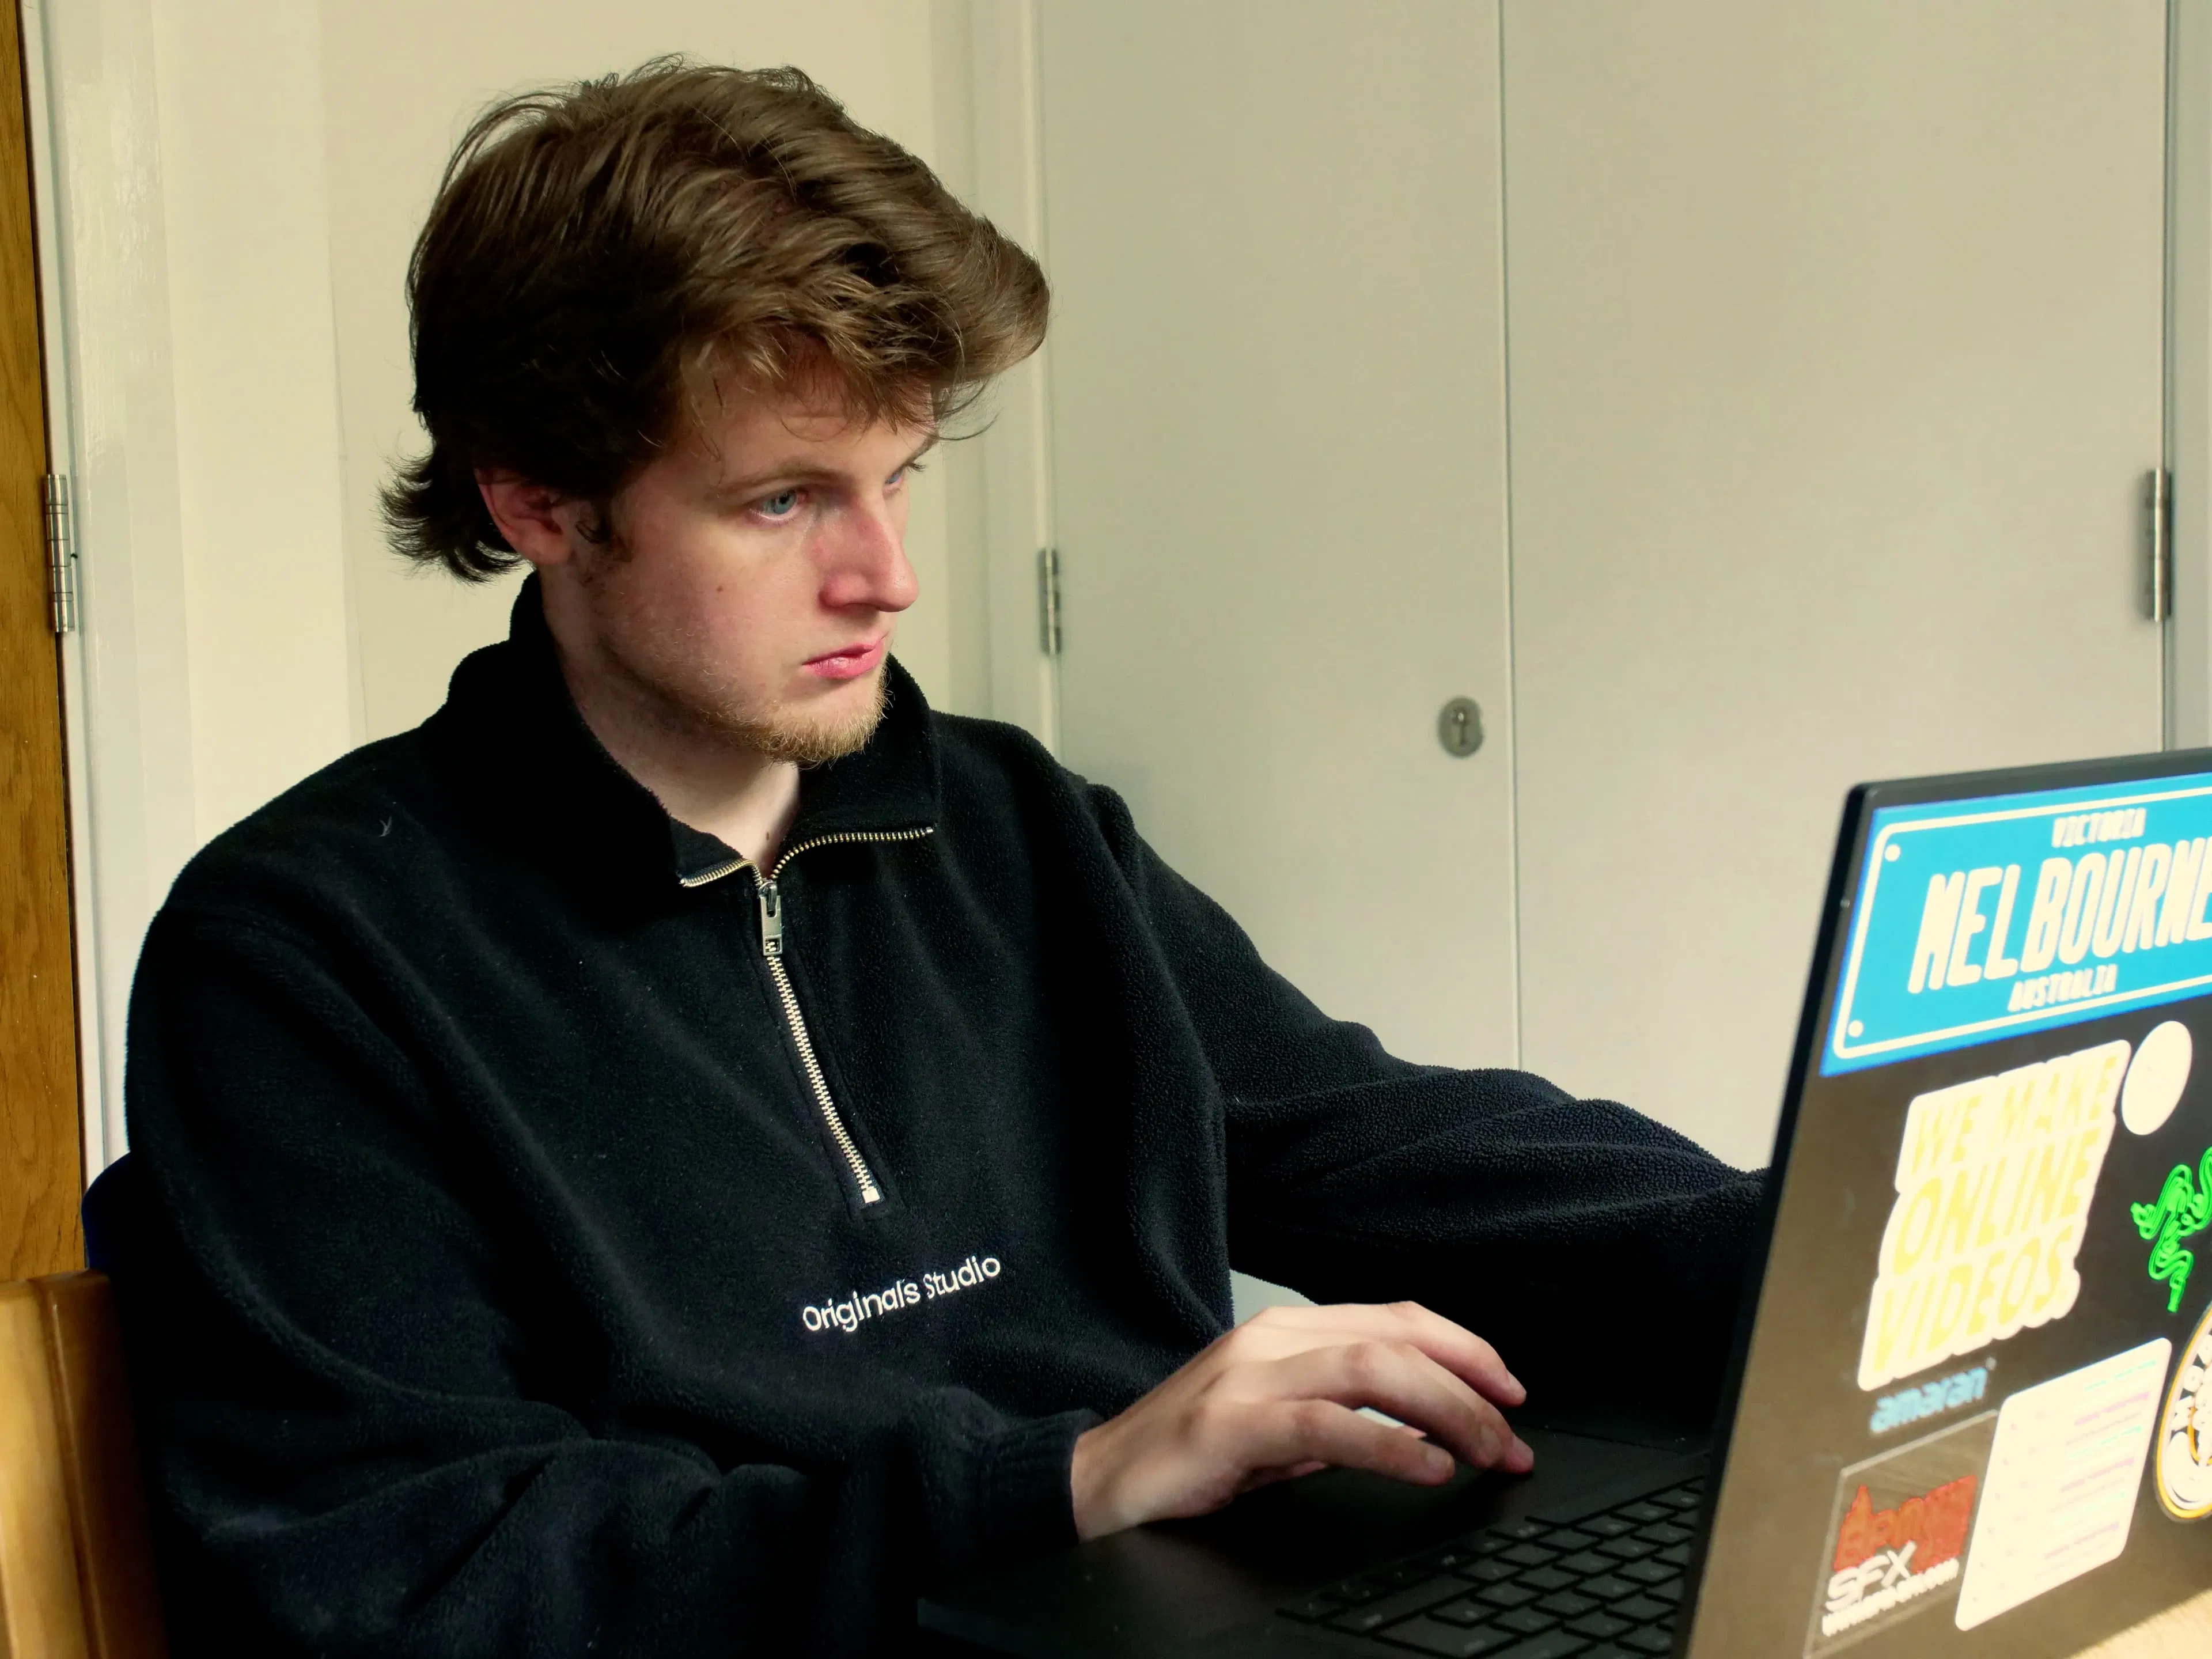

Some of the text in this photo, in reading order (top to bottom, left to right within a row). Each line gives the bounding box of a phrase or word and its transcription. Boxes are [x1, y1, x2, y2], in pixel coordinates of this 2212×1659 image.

[2008, 964, 2118, 1012] AUSTRALIA
[1909, 1094, 1982, 1176] WE
[1893, 1126, 2101, 1276] ONLINE
[802, 1255, 1001, 1332] Originals Studio
[1873, 1225, 2074, 1373] VIDEOS
[1824, 1540, 1918, 1613] SFX
